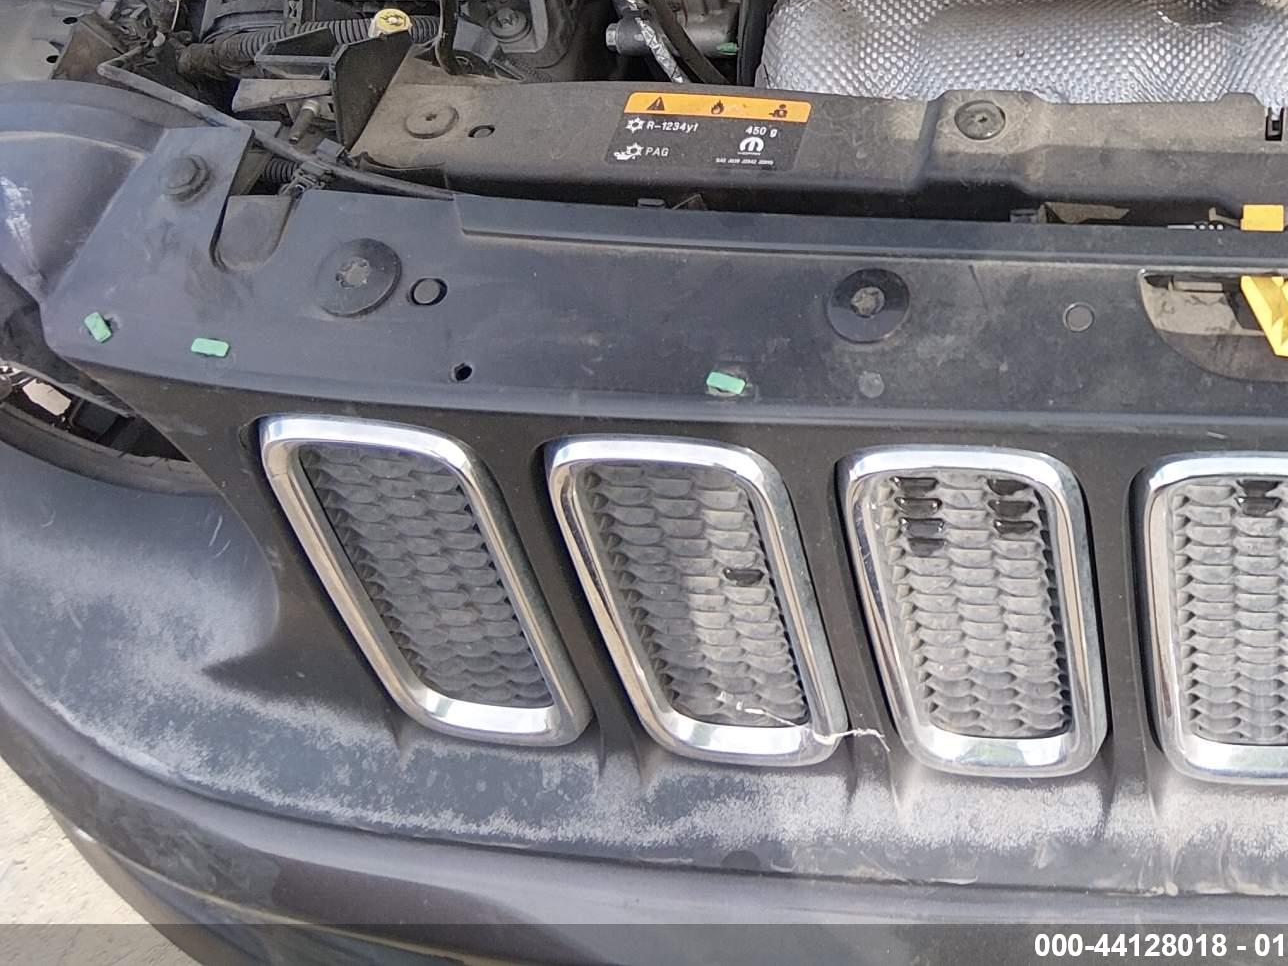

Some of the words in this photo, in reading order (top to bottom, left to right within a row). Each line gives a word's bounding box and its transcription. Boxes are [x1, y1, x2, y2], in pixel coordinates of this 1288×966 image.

[647, 120, 698, 133] R-1234yf
[745, 126, 767, 135] 450
[645, 147, 669, 156] PAG
